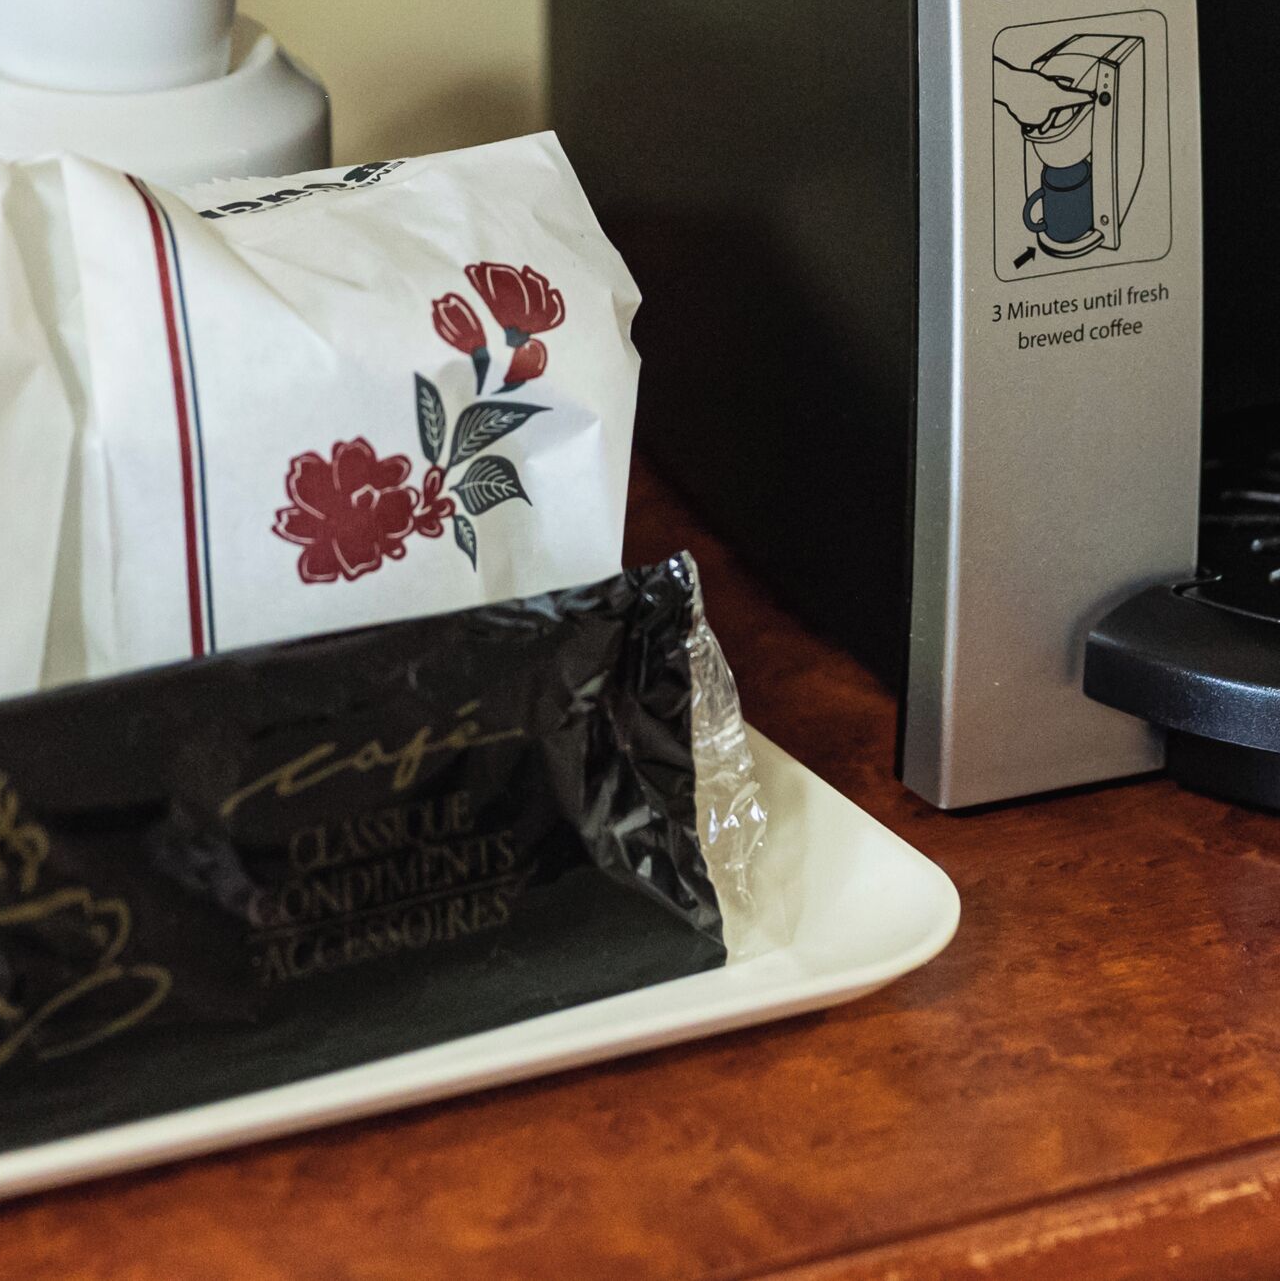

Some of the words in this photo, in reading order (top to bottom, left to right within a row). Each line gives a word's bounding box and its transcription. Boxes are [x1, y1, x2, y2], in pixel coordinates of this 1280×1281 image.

[991, 304, 1003, 323] 3
[1007, 297, 1079, 321] Minutes
[1083, 288, 1122, 311] until
[1126, 282, 1170, 305] fresh
[1017, 323, 1085, 350] brewed
[1089, 318, 1144, 341] coffee
[247, 829, 518, 925] CONDIMENTS
